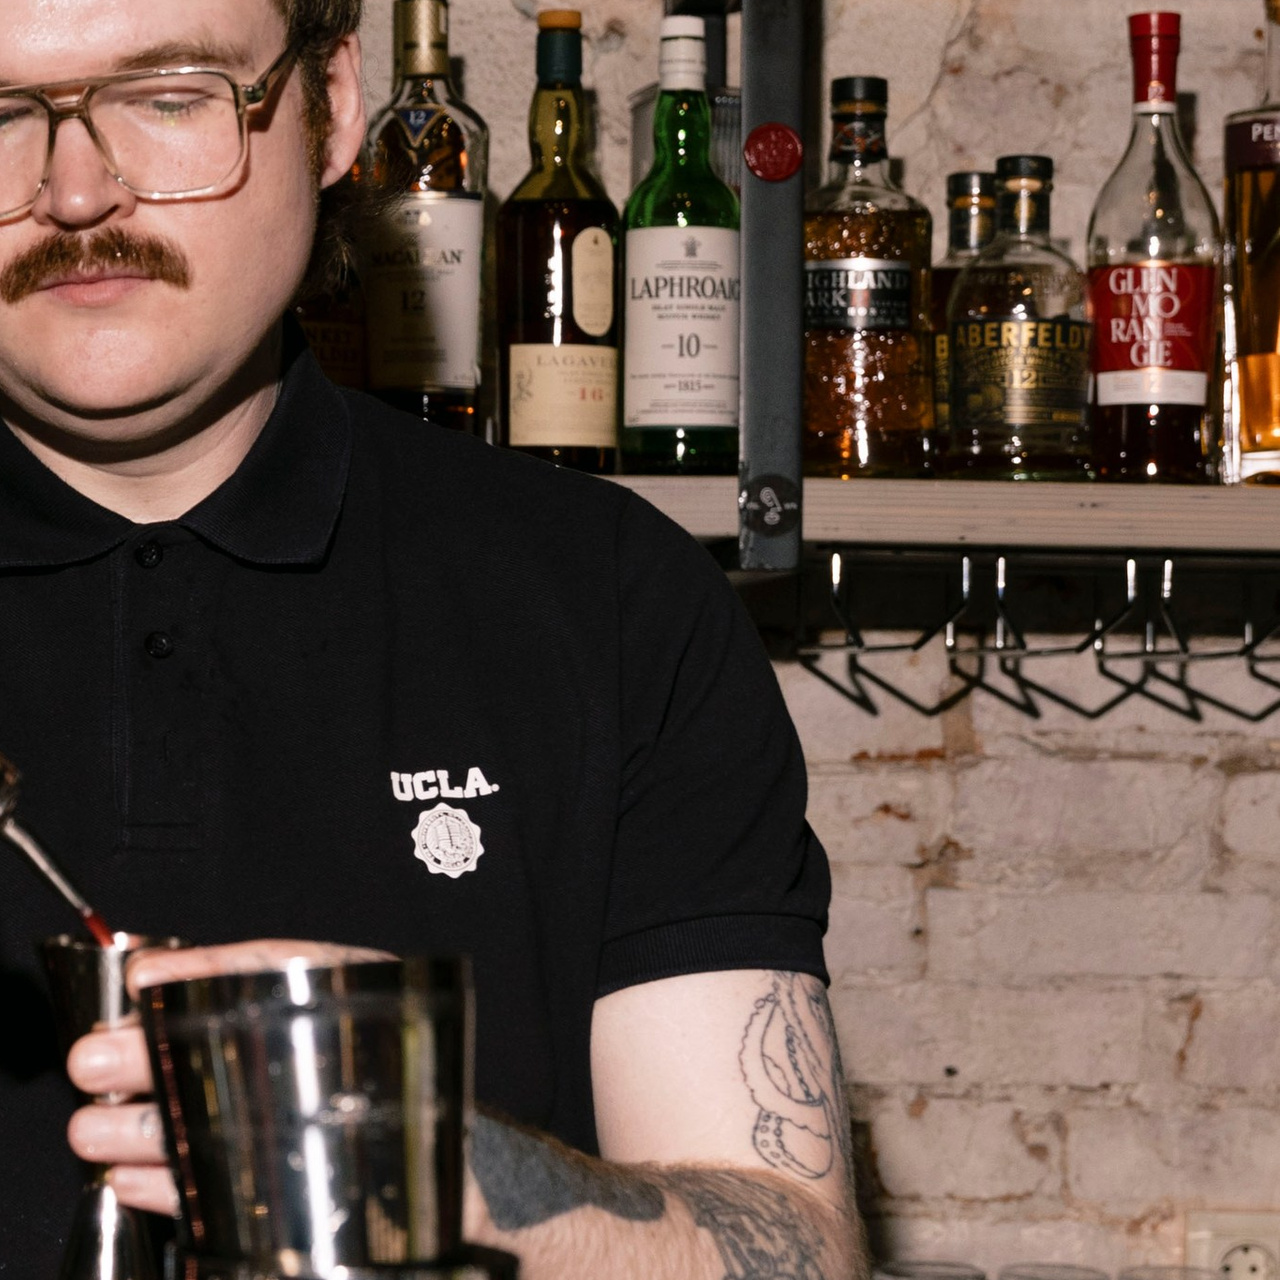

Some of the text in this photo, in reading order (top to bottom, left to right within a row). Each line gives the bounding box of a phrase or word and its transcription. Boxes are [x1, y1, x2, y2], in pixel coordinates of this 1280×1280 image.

[806, 270, 910, 290] IGHLAND
[1108, 268, 1179, 295] GLEN
[802, 289, 847, 308] ARK
[1130, 292, 1181, 318] MO
[956, 322, 1093, 348] ABERFELDY
[1110, 317, 1164, 343] RAN
[677, 332, 701, 358] 10
[1129, 340, 1173, 367] GIE
[579, 387, 604, 401] 16
[390, 766, 494, 802] UCLA
